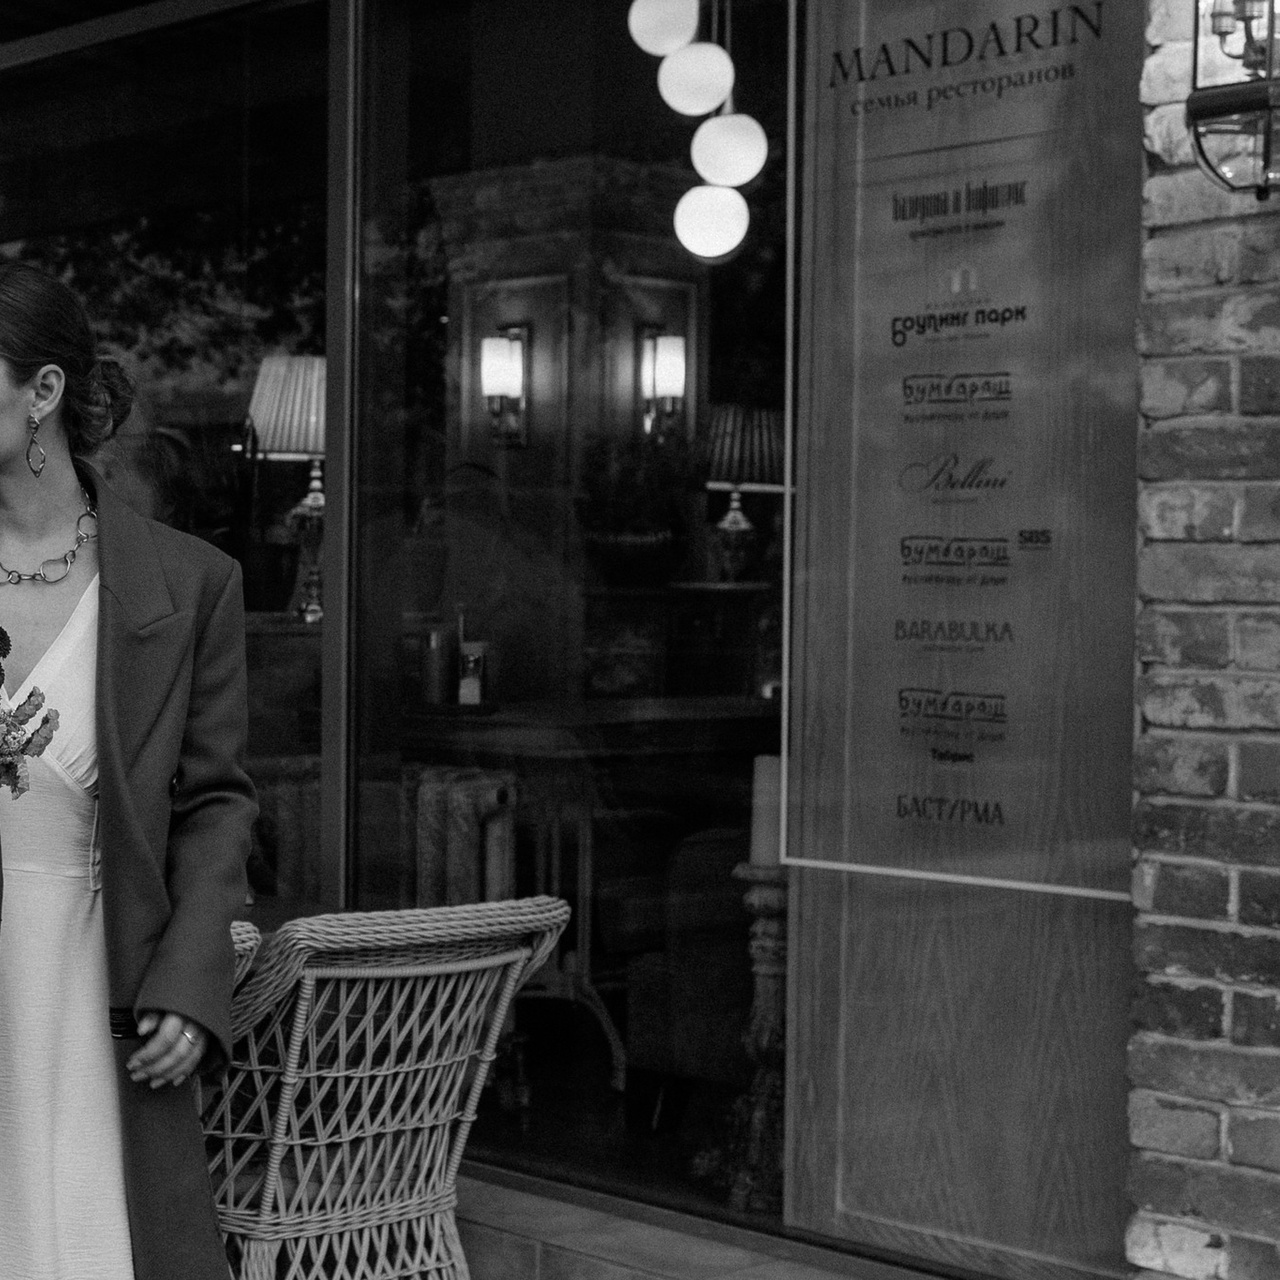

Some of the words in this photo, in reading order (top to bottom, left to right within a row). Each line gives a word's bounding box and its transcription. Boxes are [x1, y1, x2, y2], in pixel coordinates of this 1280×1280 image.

[828, 0, 1105, 88] MANDARIN
[851, 90, 918, 117] семья
[926, 62, 1075, 111] ресторанов
[974, 306, 1027, 326] парк
[898, 452, 1012, 494] Bellini
[894, 618, 1015, 643] BARABULKA
